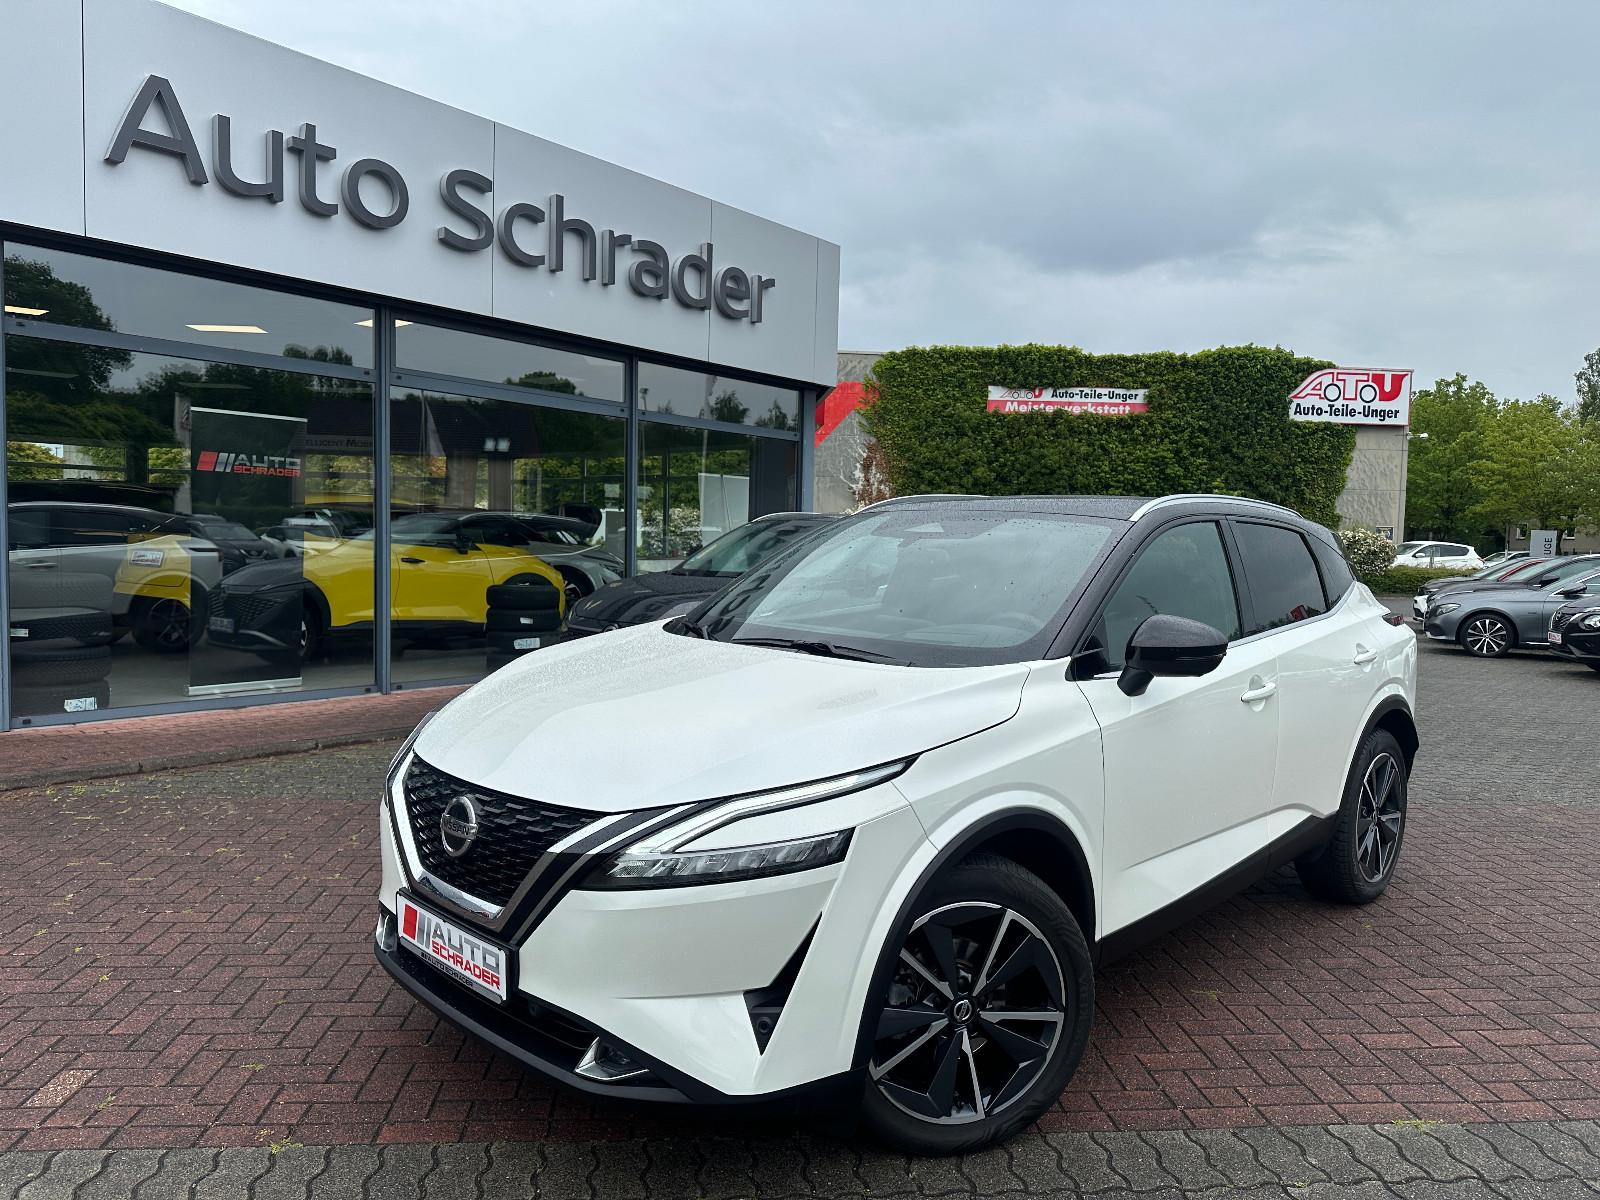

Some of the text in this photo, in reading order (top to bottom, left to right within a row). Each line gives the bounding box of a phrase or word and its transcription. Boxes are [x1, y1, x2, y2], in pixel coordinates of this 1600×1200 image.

[104, 74, 776, 323] Auto Schrader
[1051, 389, 1139, 402] Auto-Teile-Unger
[1294, 403, 1399, 421] Auto-Teile-Unger
[234, 453, 301, 469] AUTO
[233, 465, 301, 477] SCHRADER
[1543, 537, 1553, 558] UGE
[432, 921, 500, 976] AUTO
[432, 939, 500, 990] SCHRADER
